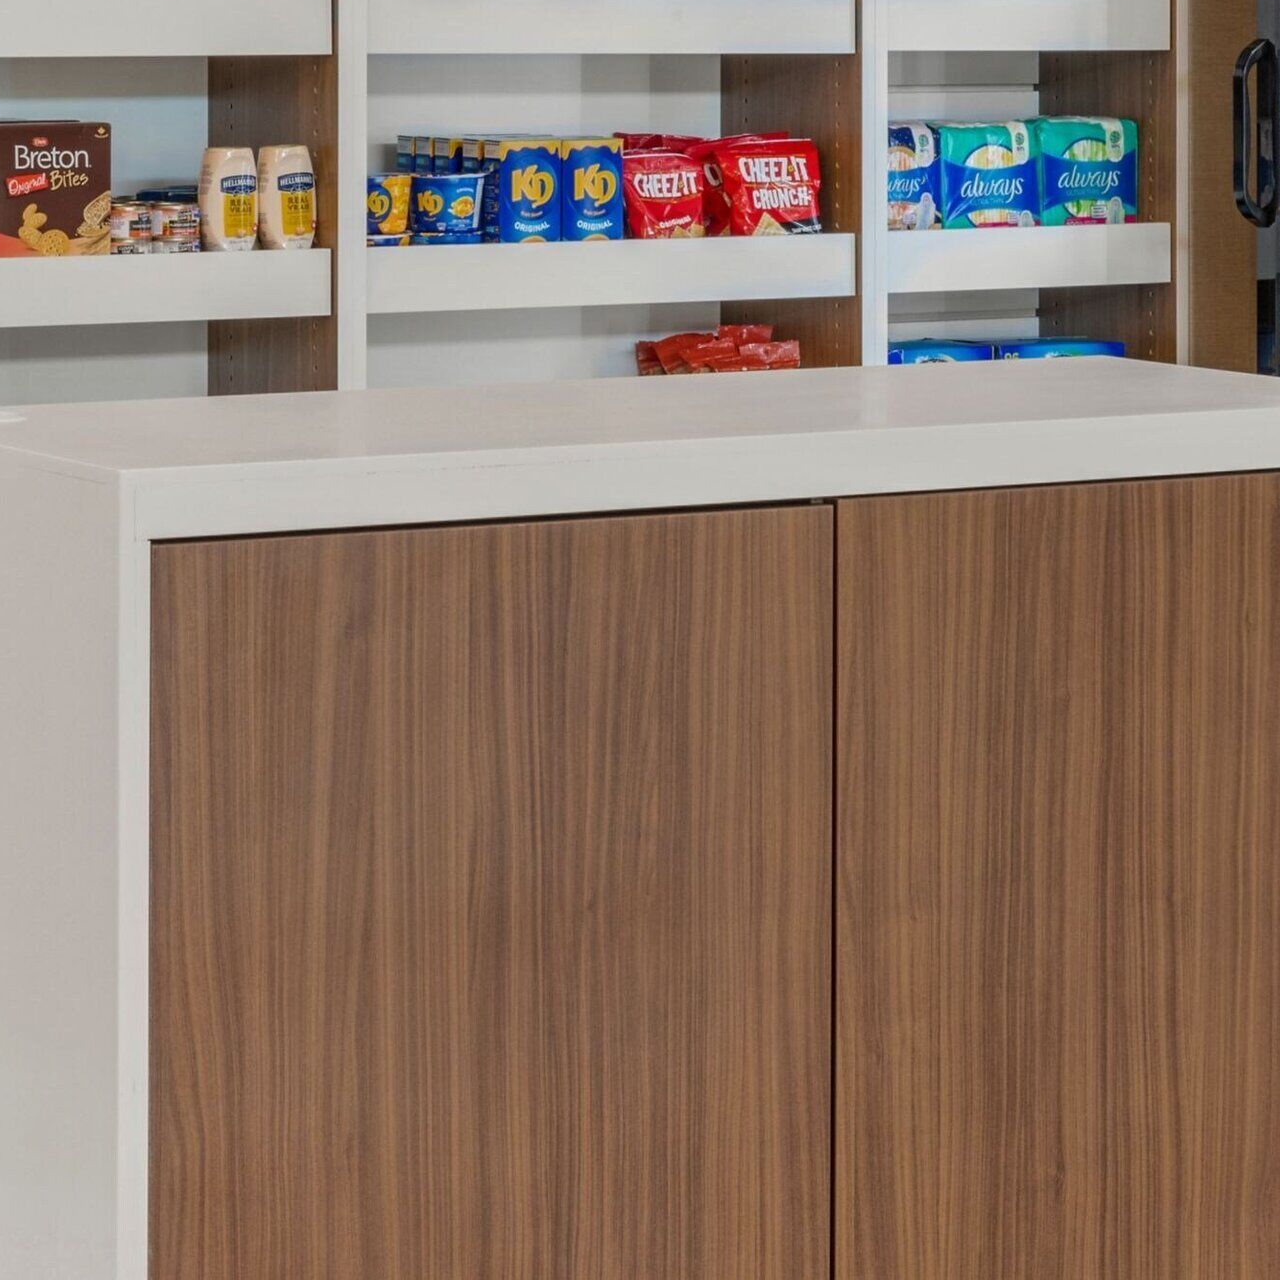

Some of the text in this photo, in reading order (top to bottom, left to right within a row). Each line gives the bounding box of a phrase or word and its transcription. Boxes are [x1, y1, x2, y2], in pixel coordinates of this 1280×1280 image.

[50, 169, 89, 191] Bites
[511, 163, 554, 209] KD
[574, 162, 617, 208] KD
[960, 172, 1025, 204] always
[1057, 164, 1121, 194] always
[417, 189, 444, 216] KD
[751, 185, 810, 210] CRUNCH
[513, 220, 551, 233] ORIGINAL
[576, 219, 613, 231] ORIGINAL
